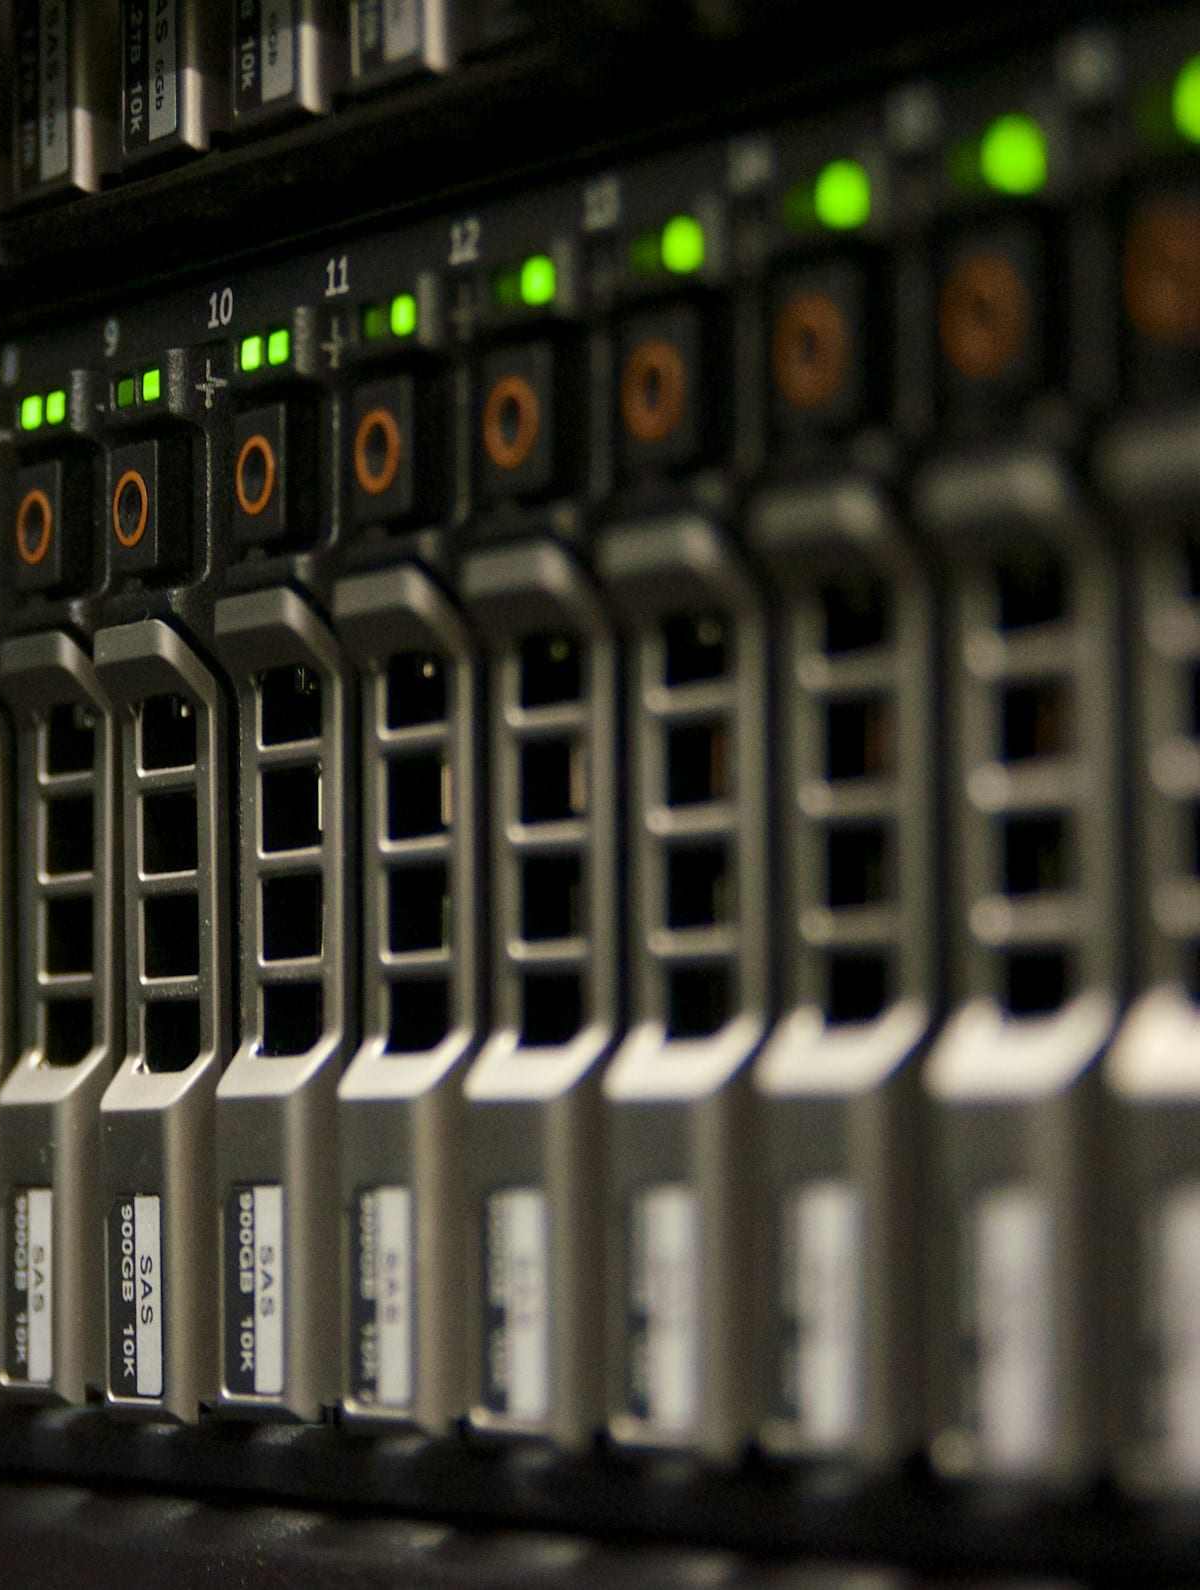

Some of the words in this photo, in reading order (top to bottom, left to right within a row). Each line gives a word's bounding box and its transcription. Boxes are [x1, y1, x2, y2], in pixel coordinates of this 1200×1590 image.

[130, 81, 144, 134] 10K
[448, 216, 481, 266] 12
[325, 255, 350, 298] 11
[206, 286, 234, 329] 10
[104, 316, 120, 357] 9
[121, 1204, 135, 1303] 900GB
[239, 1192, 254, 1294] 900GB
[31, 1245, 45, 1312] SAS
[140, 1255, 154, 1325] SAS
[260, 1245, 274, 1317] SAS
[122, 1324, 136, 1377] 10K
[239, 1316, 254, 1372] 10K
